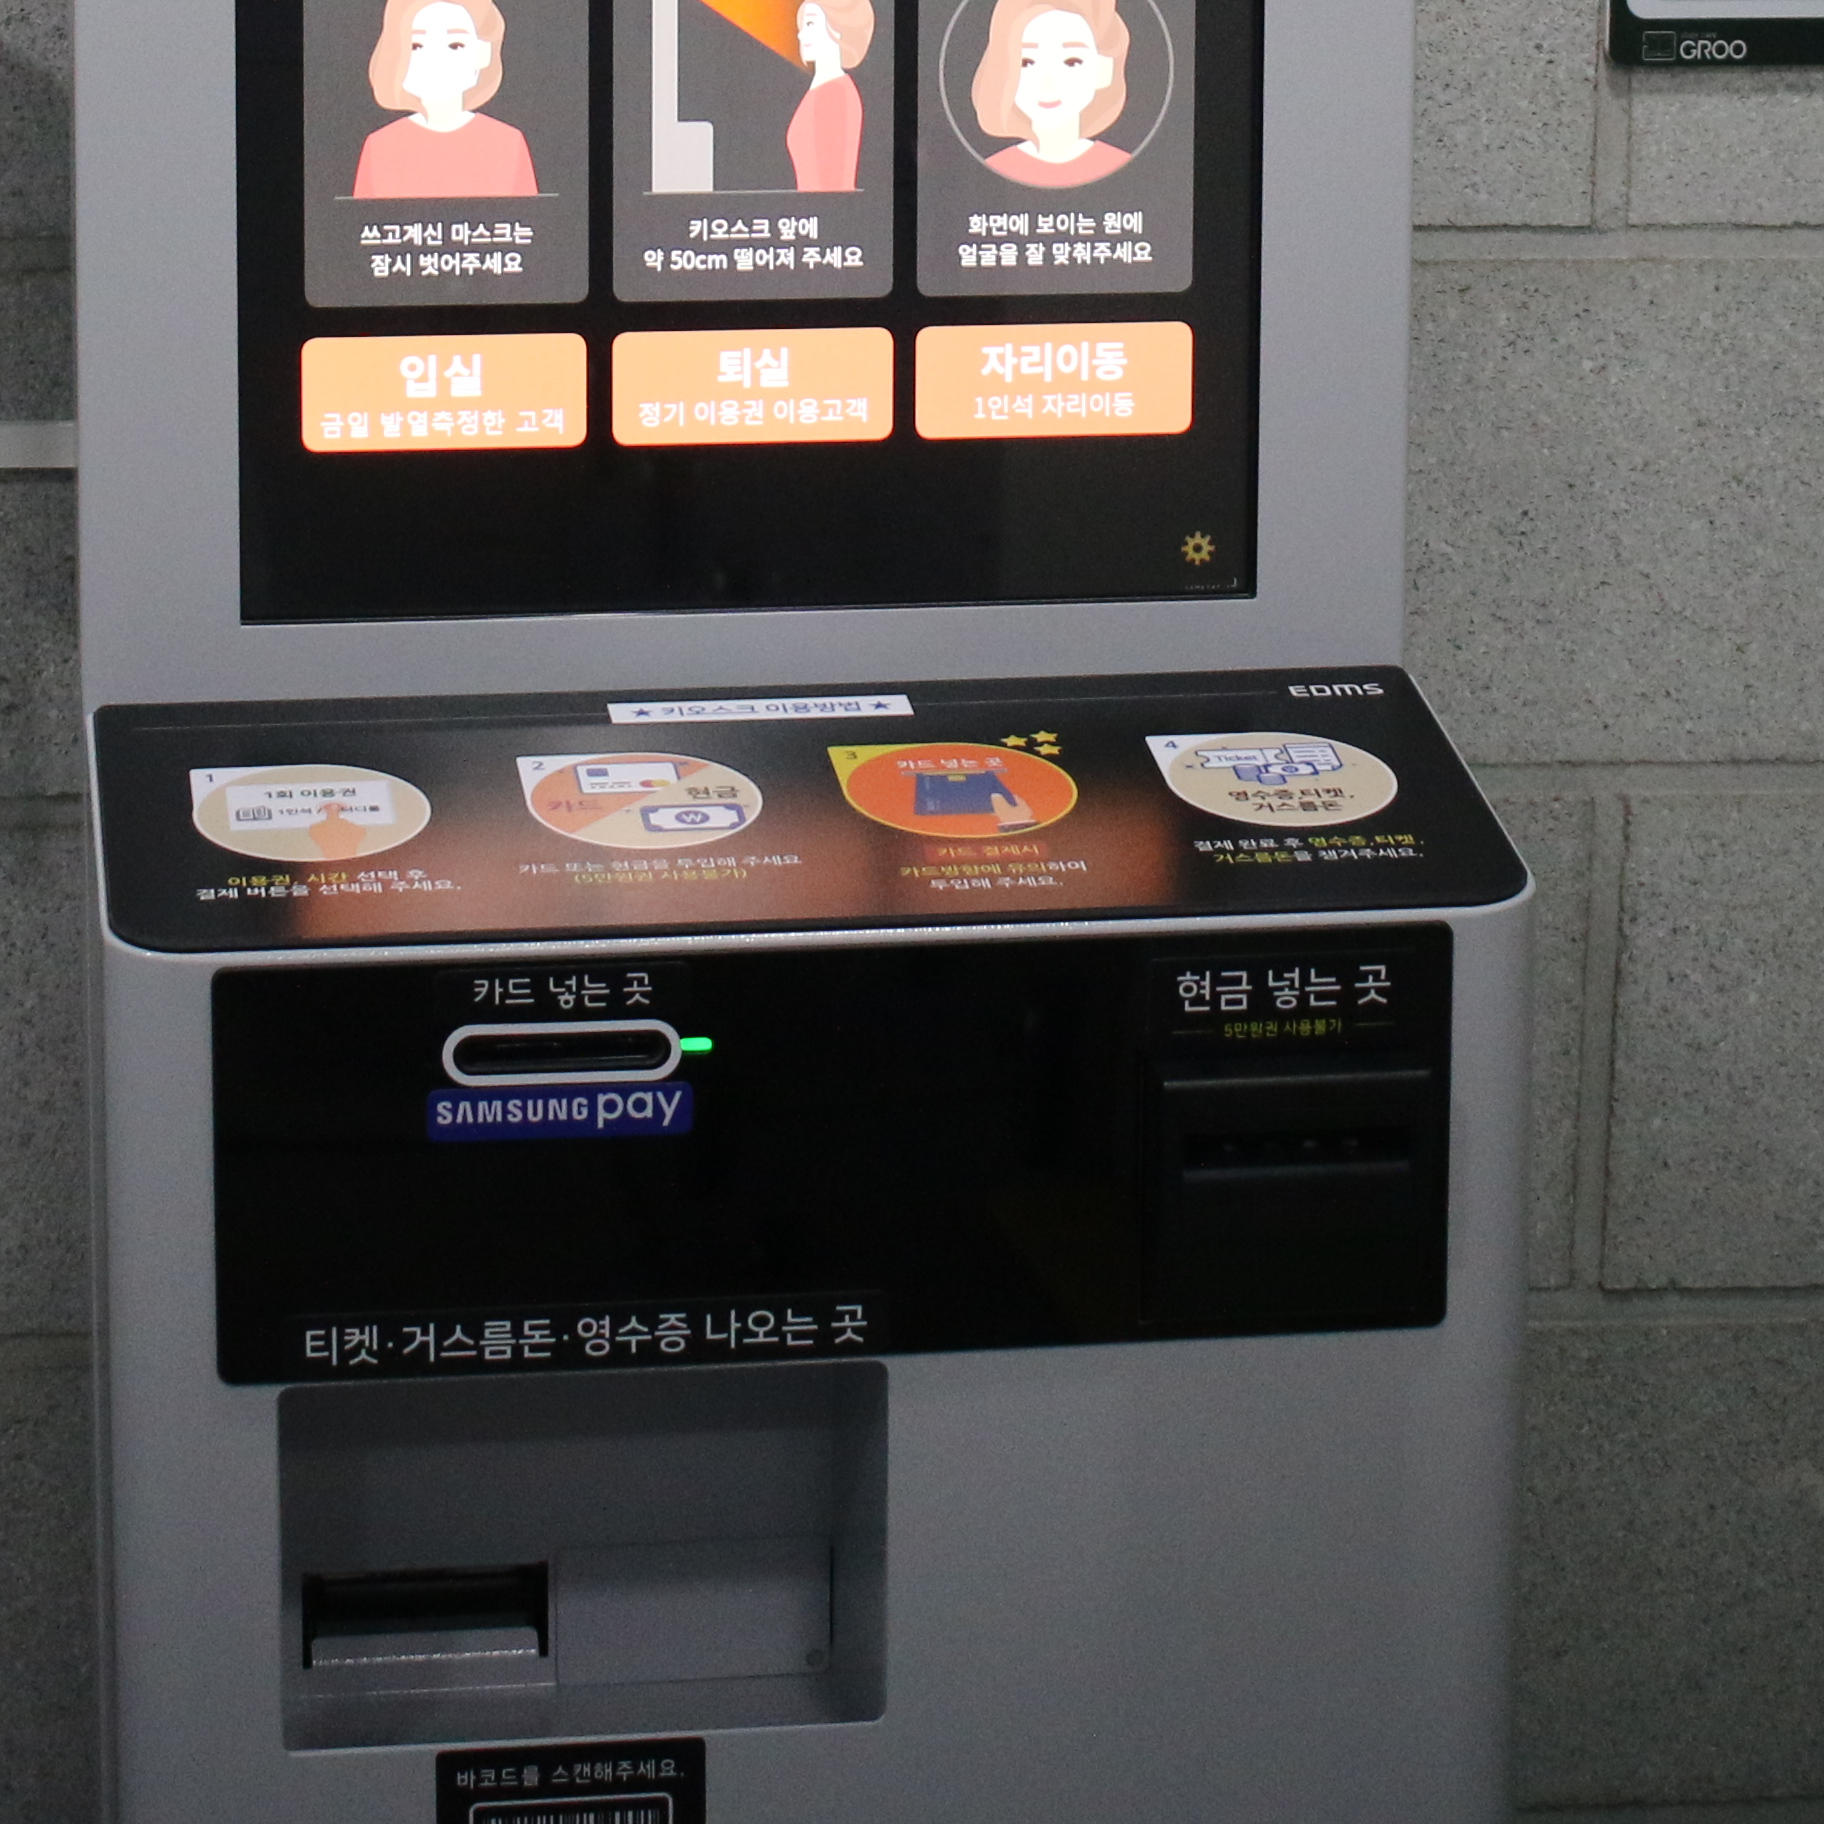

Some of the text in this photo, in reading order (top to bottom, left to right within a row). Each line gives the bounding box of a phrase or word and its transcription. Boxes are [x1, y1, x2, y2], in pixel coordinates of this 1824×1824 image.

[1679, 39, 1748, 60] GROO
[360, 220, 533, 248] 쓰고계신 마스크는
[688, 216, 819, 242] 키오스크 앞에
[967, 210, 1144, 237] 화면에 보이는 원에
[370, 250, 523, 277] 잠시 벗어주세요
[643, 245, 864, 272] 약 50cm 떨어져 주세요
[958, 240, 1153, 267] 얼굴을 잘 맞춰주세요
[716, 347, 791, 390] 퇴실
[980, 341, 1128, 382] 자리이동
[399, 353, 485, 399] 입실
[638, 397, 869, 427] 정기 이용권 이용고객
[973, 391, 1134, 420] 1인석 자리이동
[320, 407, 566, 438] 금일 발열측정한 고객
[1287, 682, 1385, 698] EDMS
[662, 700, 862, 717] 키오스크 이용방법
[845, 750, 858, 760] 3
[1164, 740, 1178, 749] 4
[531, 761, 546, 771] 2
[1213, 754, 1259, 763] Ticket
[206, 773, 214, 783] 1
[265, 787, 357, 799] 1회 이용권
[684, 786, 741, 800] 현금
[473, 972, 653, 1010] 카드 넣는 곳
[1176, 964, 1392, 1013] 현금 넣는 곳
[1223, 1018, 1344, 1040] 5만원권 사용불가
[436, 1089, 682, 1129] SAMSUNG pay
[704, 1306, 819, 1350] 나오는
[830, 1303, 869, 1346] 곳
[456, 1758, 686, 1789] 바코드를 스캔해주세요.
